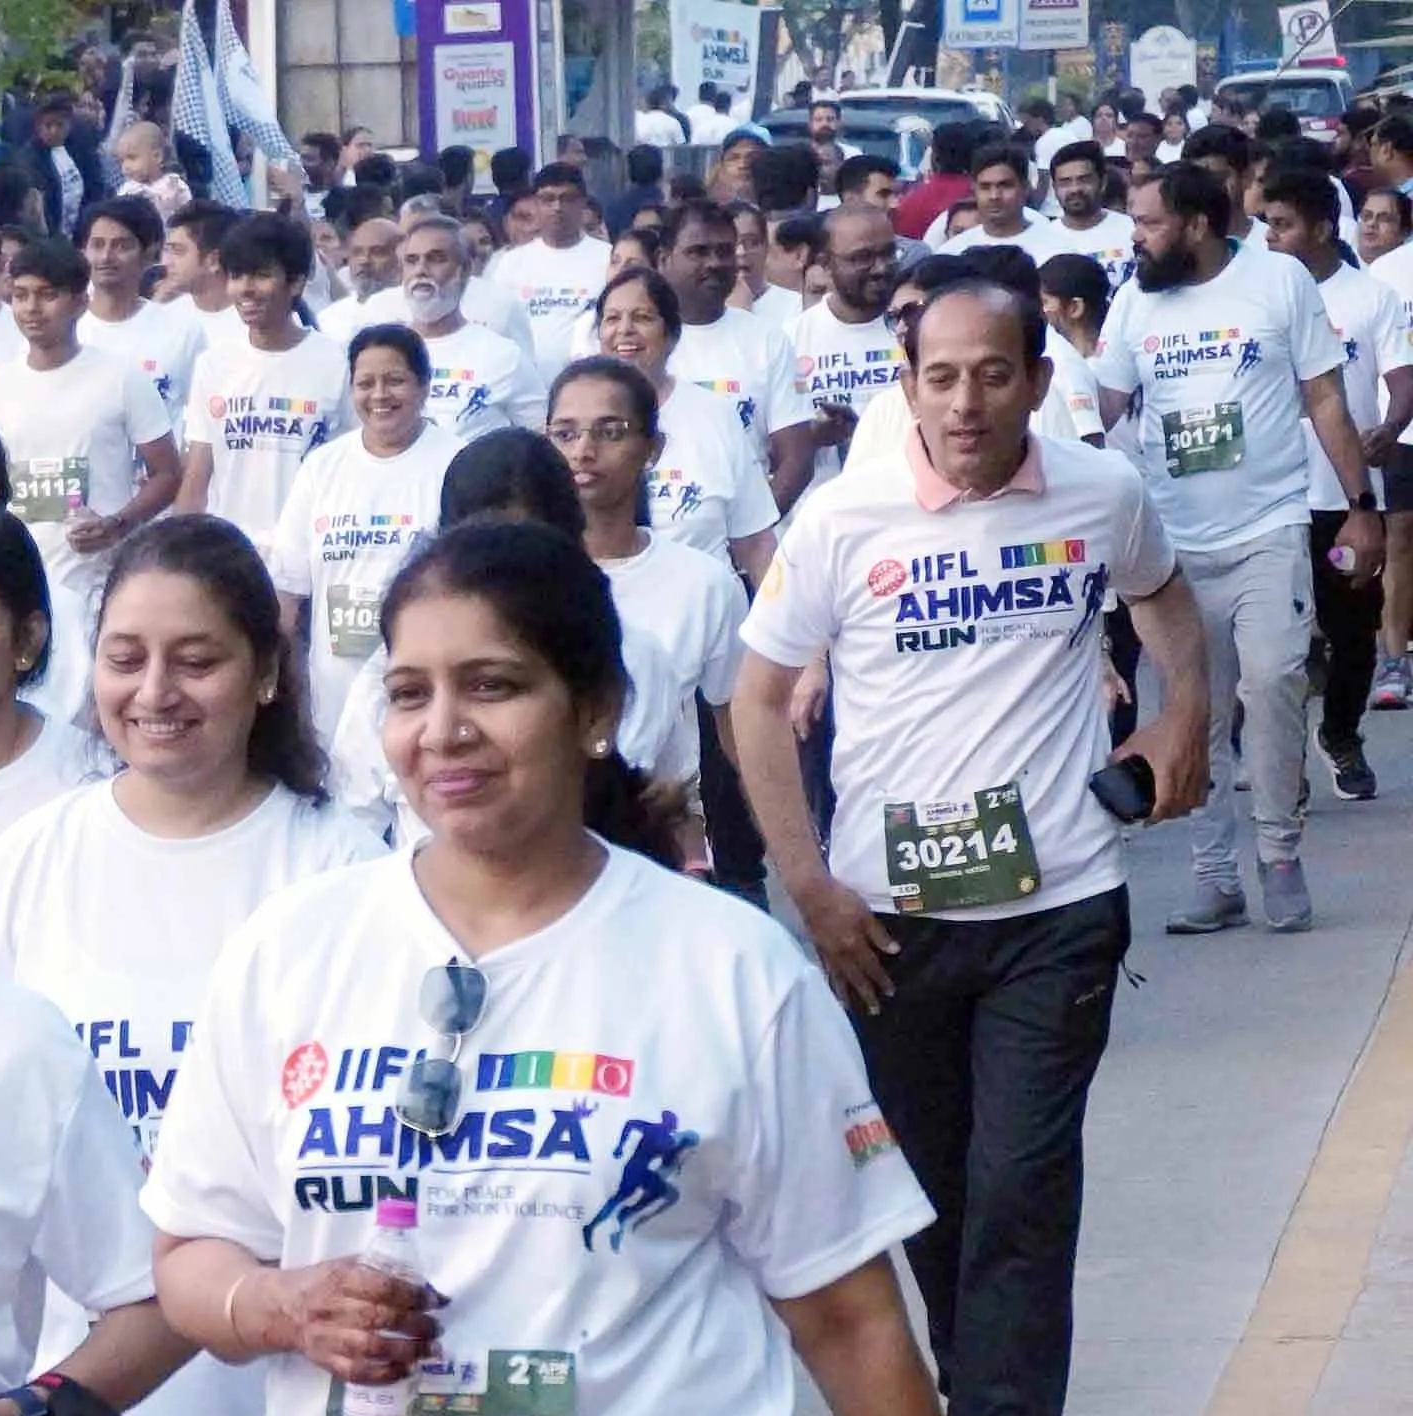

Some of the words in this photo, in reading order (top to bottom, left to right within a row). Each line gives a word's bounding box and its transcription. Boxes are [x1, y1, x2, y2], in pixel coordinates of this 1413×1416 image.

[1162, 334, 1189, 349] IIFL
[818, 353, 853, 368] IIFL
[1154, 345, 1232, 366] AHIMSA
[810, 371, 901, 392] AHIMSA
[1154, 368, 1188, 380] RUN
[228, 396, 256, 413] IIFL
[225, 416, 303, 436] AHIMSA
[331, 514, 360, 528] IIFL
[322, 530, 400, 547] AHIMSA
[911, 550, 978, 584] IIFL
[896, 575, 1073, 623] AHIMSA
[896, 625, 977, 653] RUN
[897, 823, 1018, 870] 30214
[76, 1020, 140, 1058] IFL
[295, 1175, 417, 1214] RUN
[463, 1186, 515, 1201] PEACE
[427, 1202, 459, 1217] FOR
[464, 1202, 498, 1216] NON
